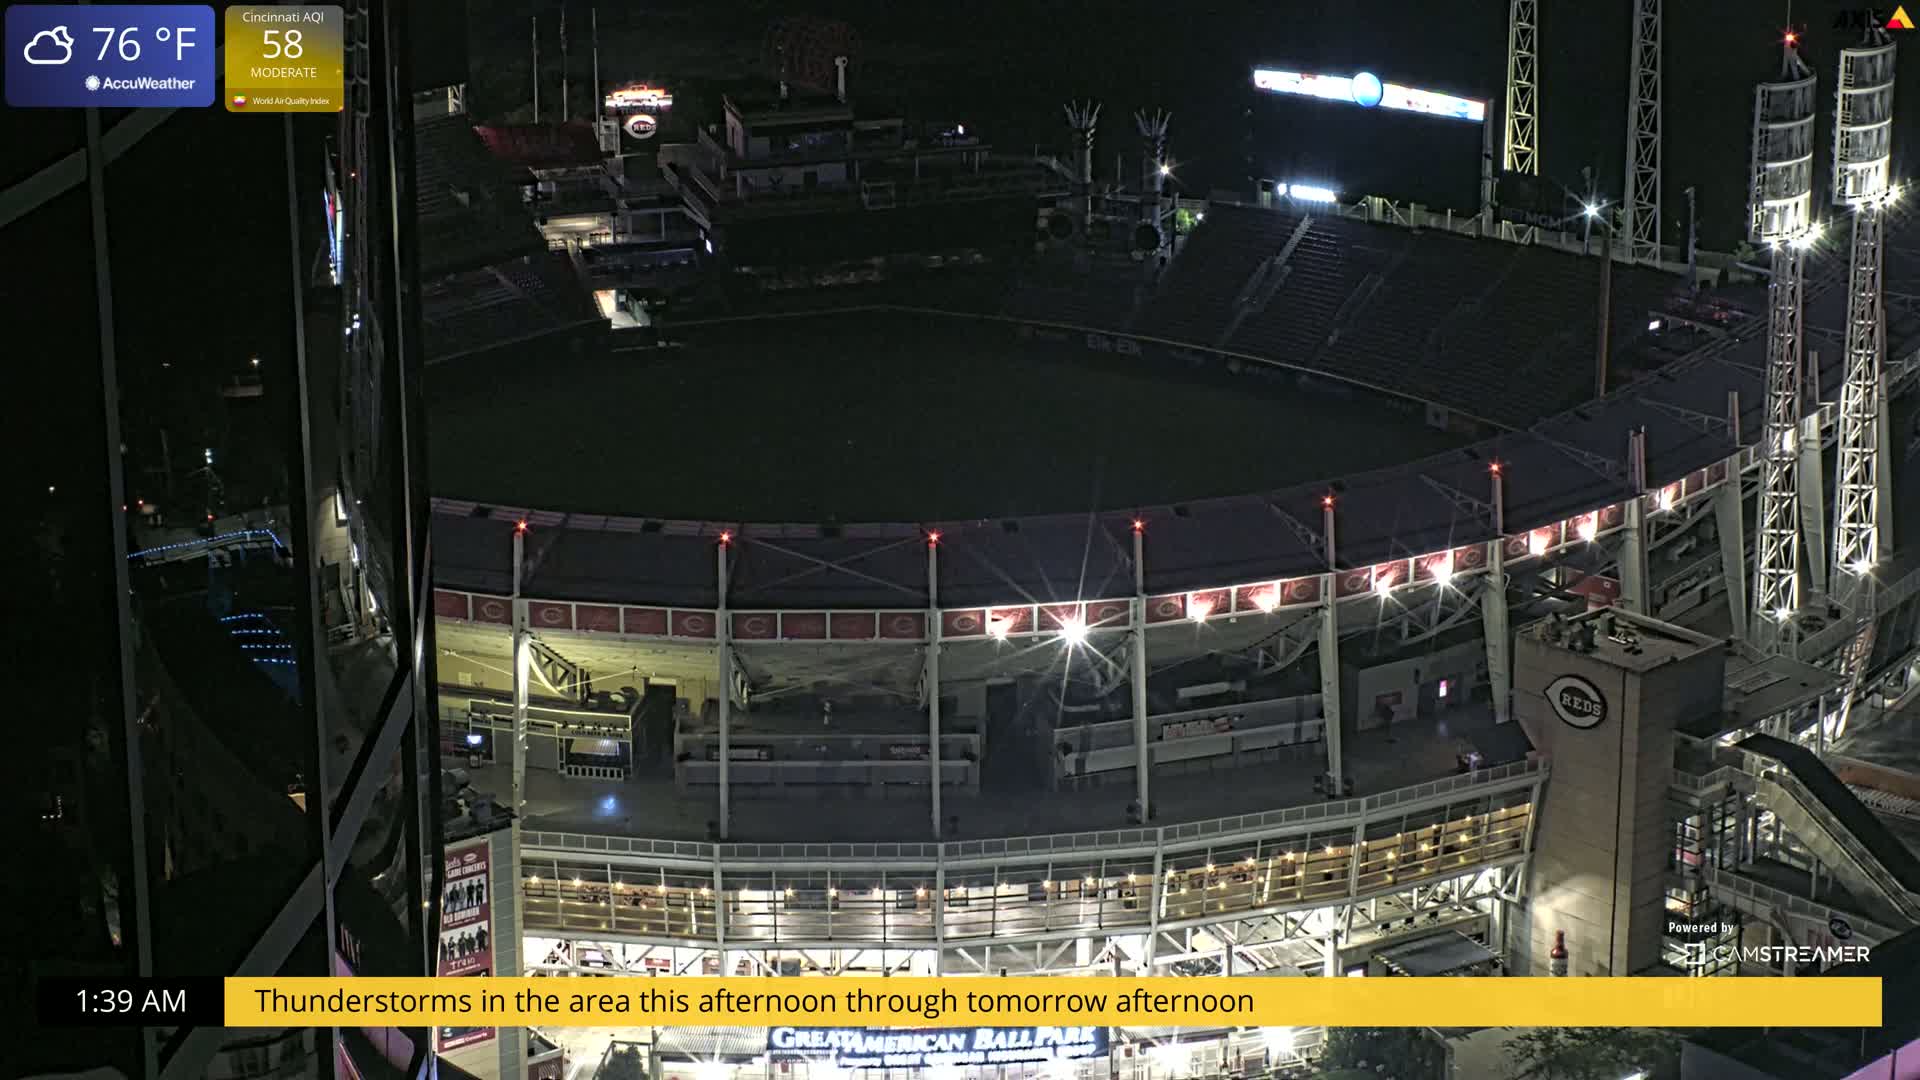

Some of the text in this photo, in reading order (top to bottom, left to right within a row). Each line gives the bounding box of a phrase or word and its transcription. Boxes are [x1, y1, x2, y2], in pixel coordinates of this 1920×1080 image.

[1561, 693, 1602, 716] REDS
[772, 1026, 1096, 1053] GREAT AMERICAN BALL PARK
